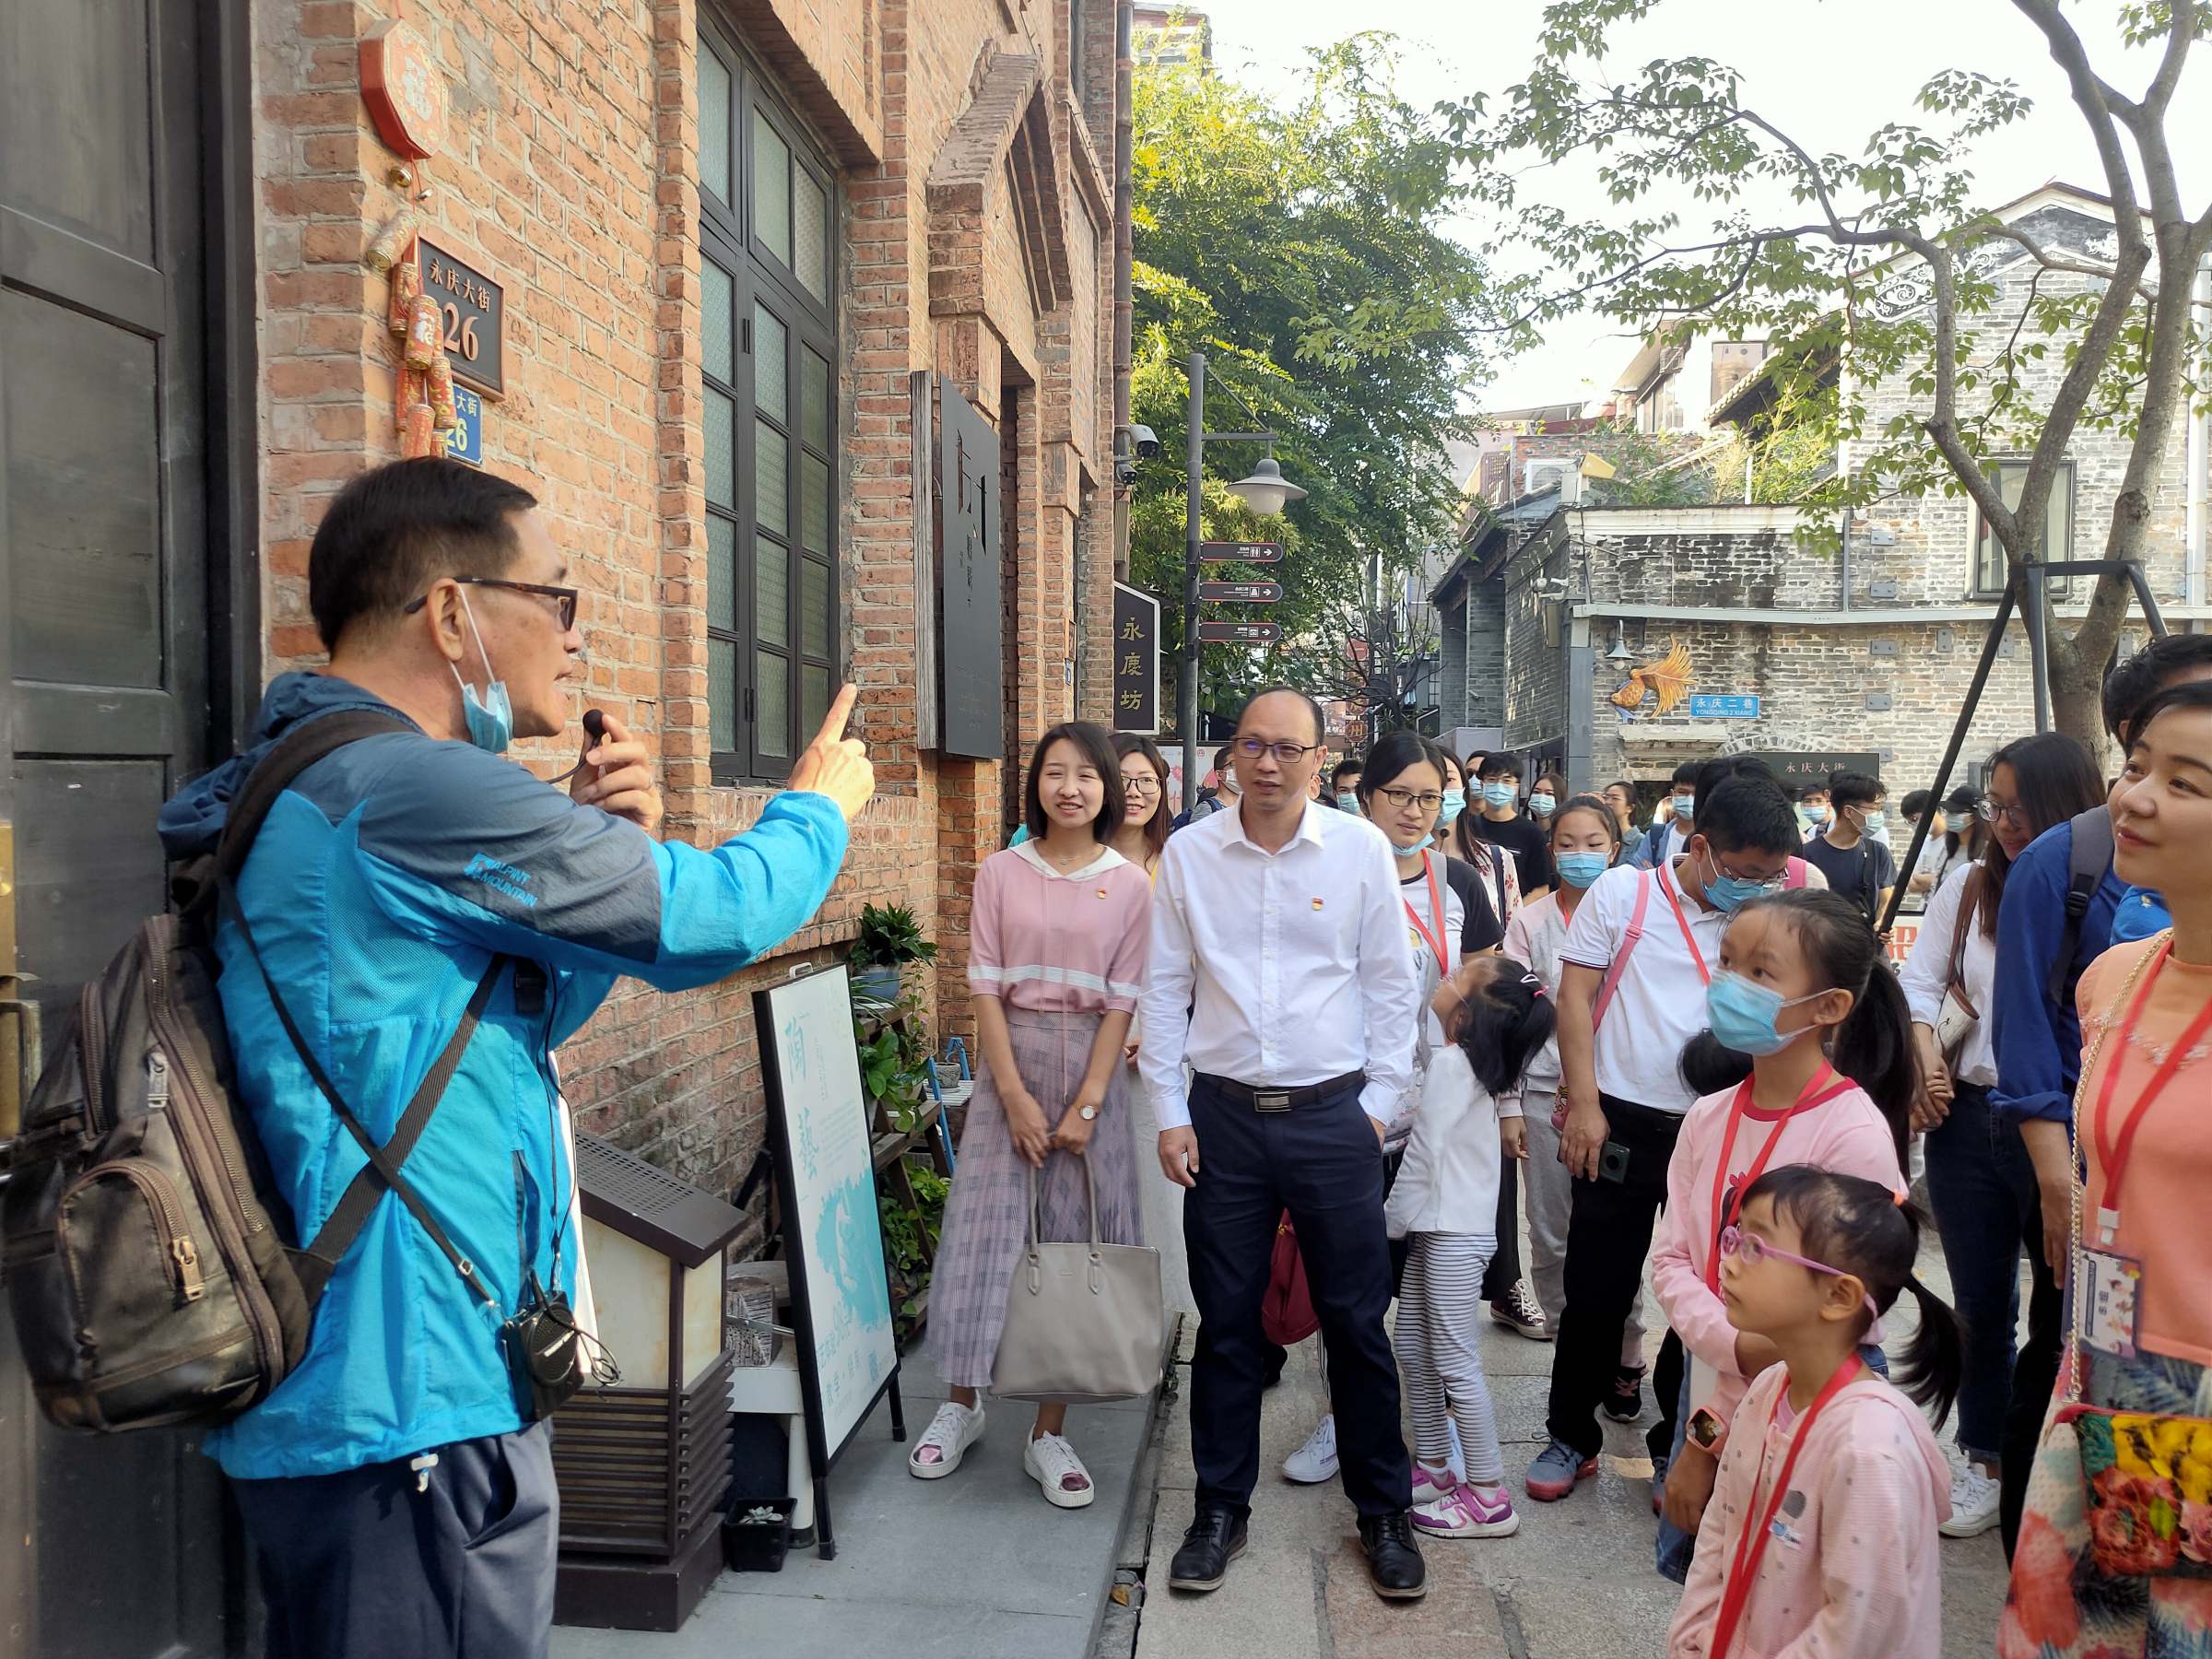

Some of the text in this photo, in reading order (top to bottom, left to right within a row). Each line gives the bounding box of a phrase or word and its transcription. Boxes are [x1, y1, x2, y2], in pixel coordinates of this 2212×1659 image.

[429, 257, 491, 313] 永庆大街
[442, 301, 479, 361] 26
[1695, 698, 1753, 709] 永庆二巷
[1784, 761, 1846, 774] 永庆大街
[490, 862, 531, 886] ALPINT
[480, 872, 539, 908] MOUNTAIN
